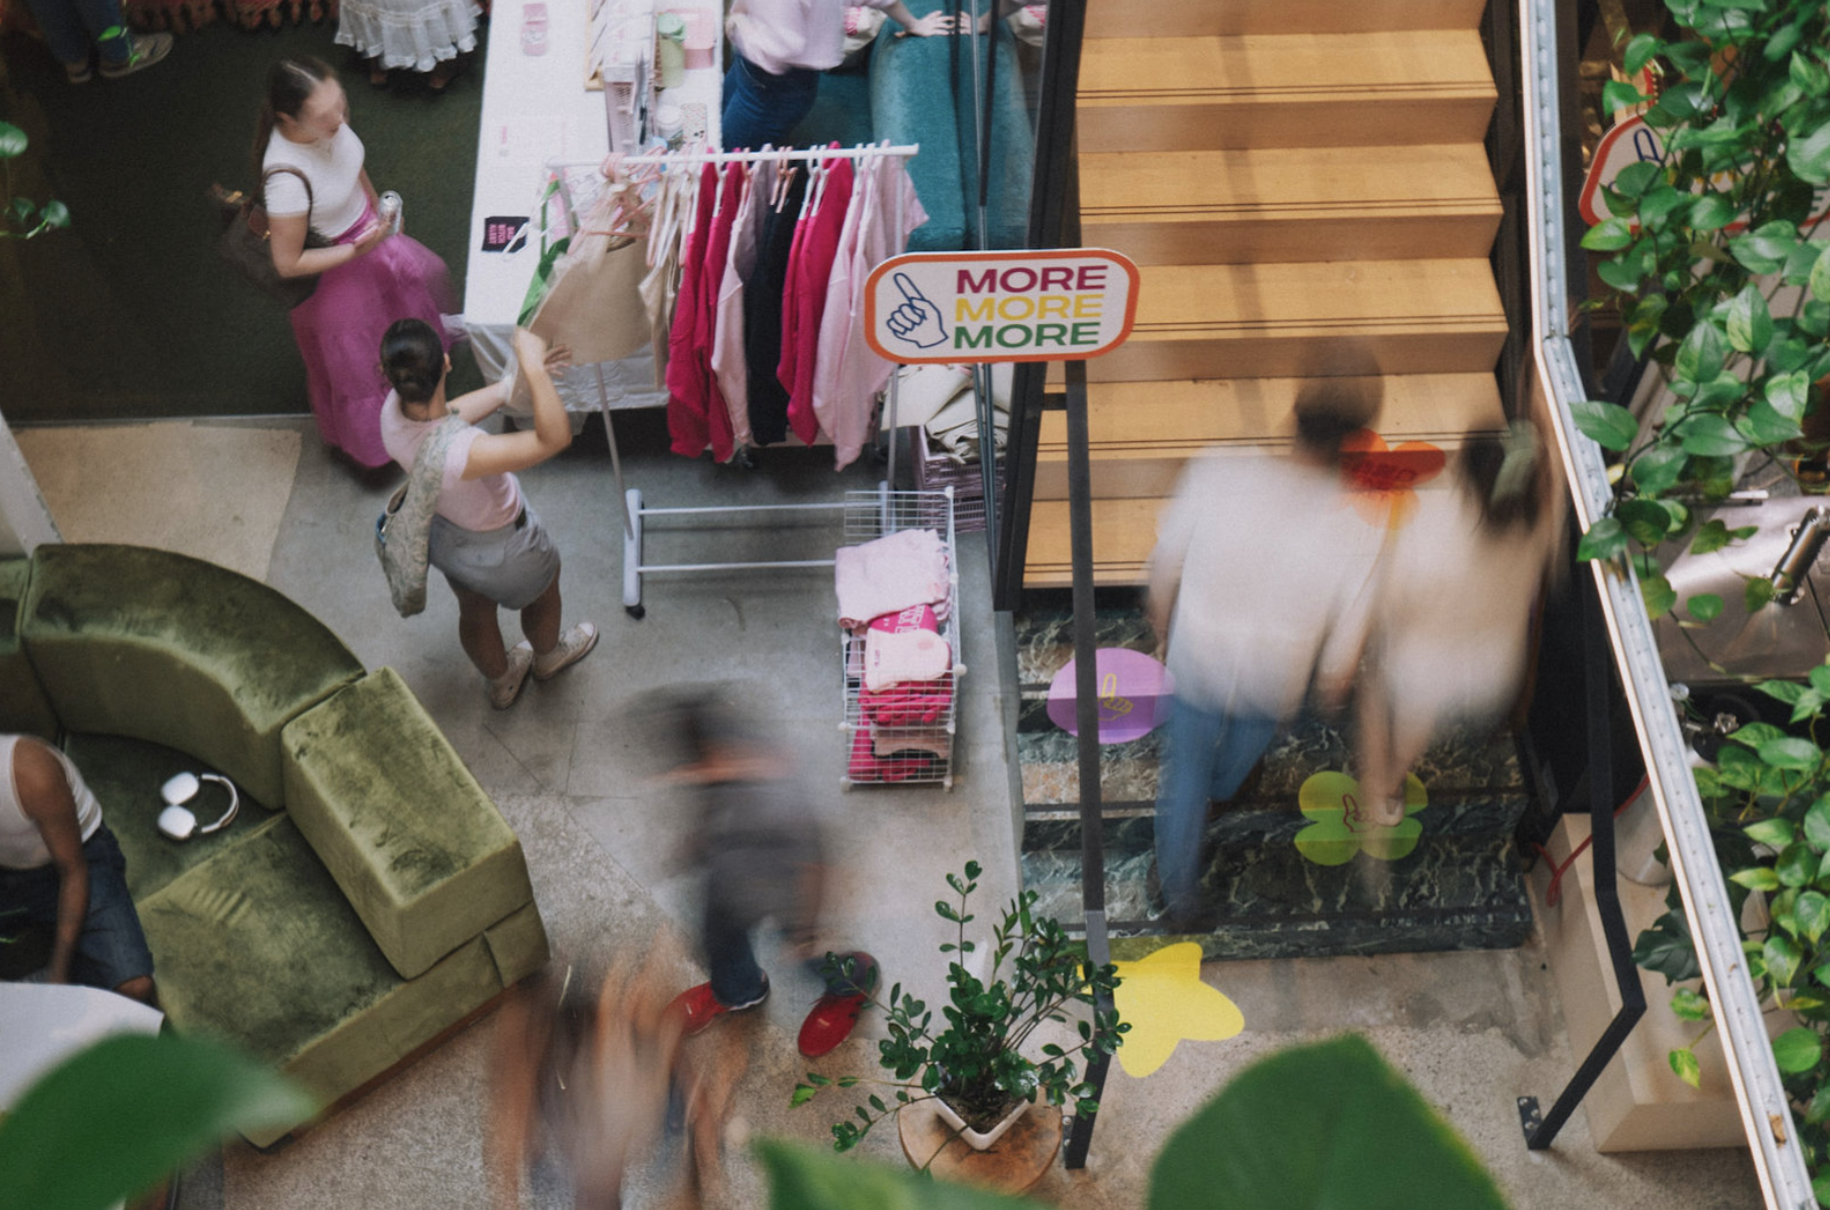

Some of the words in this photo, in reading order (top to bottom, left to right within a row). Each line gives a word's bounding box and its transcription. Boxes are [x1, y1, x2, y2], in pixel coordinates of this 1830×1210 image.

[956, 265, 1108, 294] MORE
[954, 294, 1105, 322] MORE
[953, 322, 1101, 349] MORE
